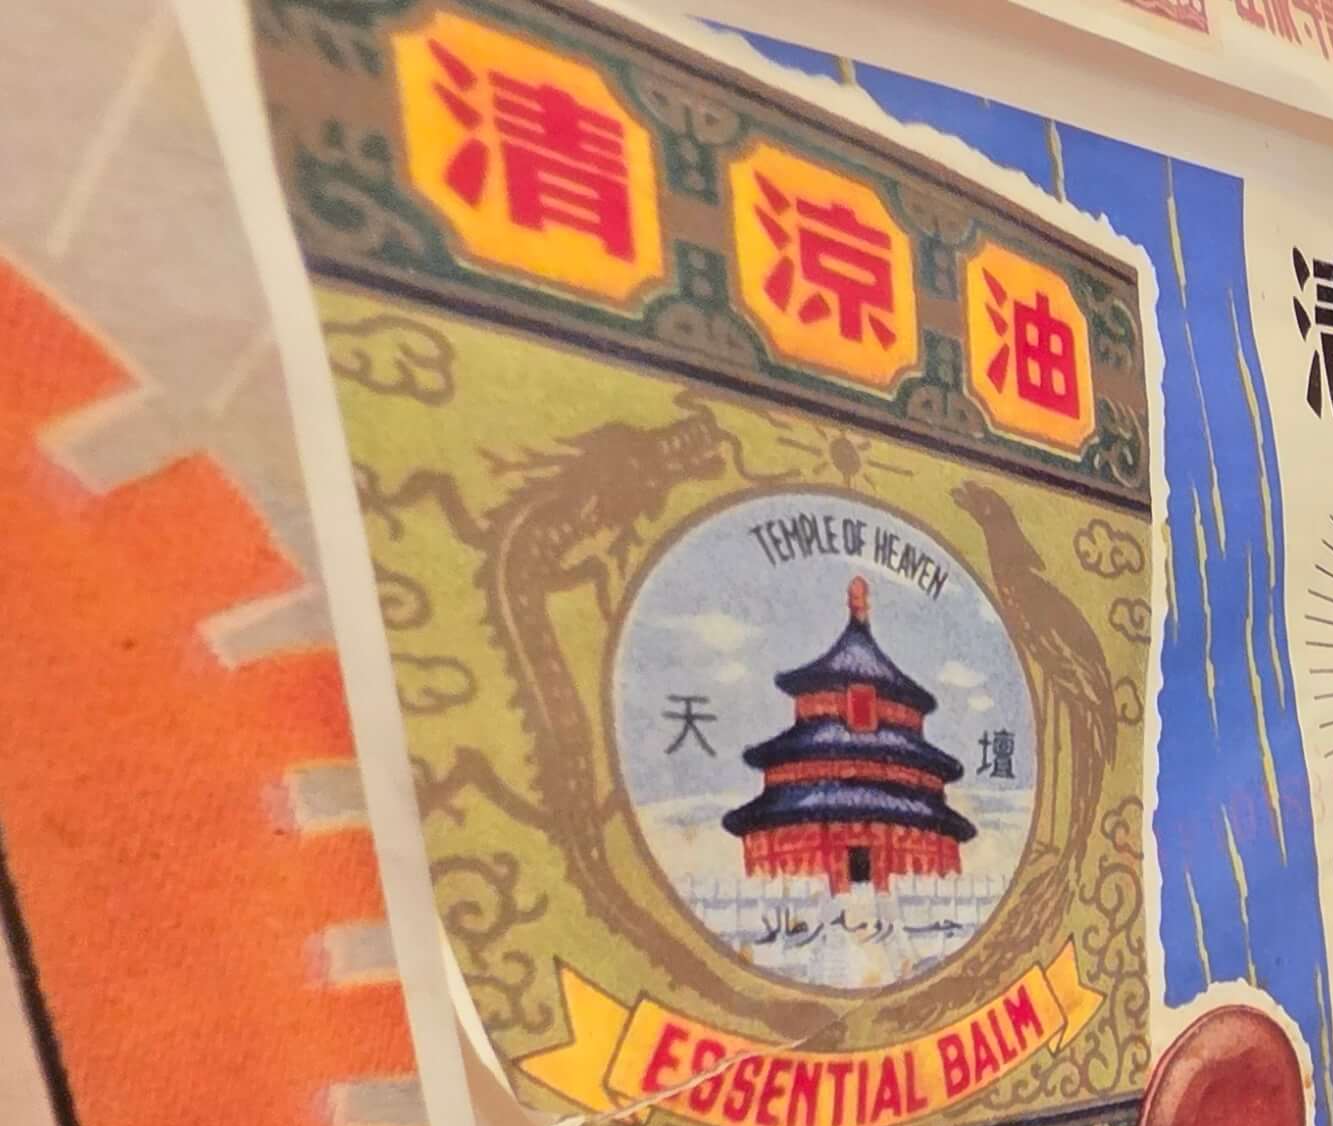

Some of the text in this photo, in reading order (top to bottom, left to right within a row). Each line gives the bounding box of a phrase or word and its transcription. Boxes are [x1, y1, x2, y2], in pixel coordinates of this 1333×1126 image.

[749, 512, 949, 600] TEMPLE OF HEAVEN
[662, 694, 718, 757] 天
[976, 729, 1016, 779] 壇
[939, 983, 1044, 1100] BALM
